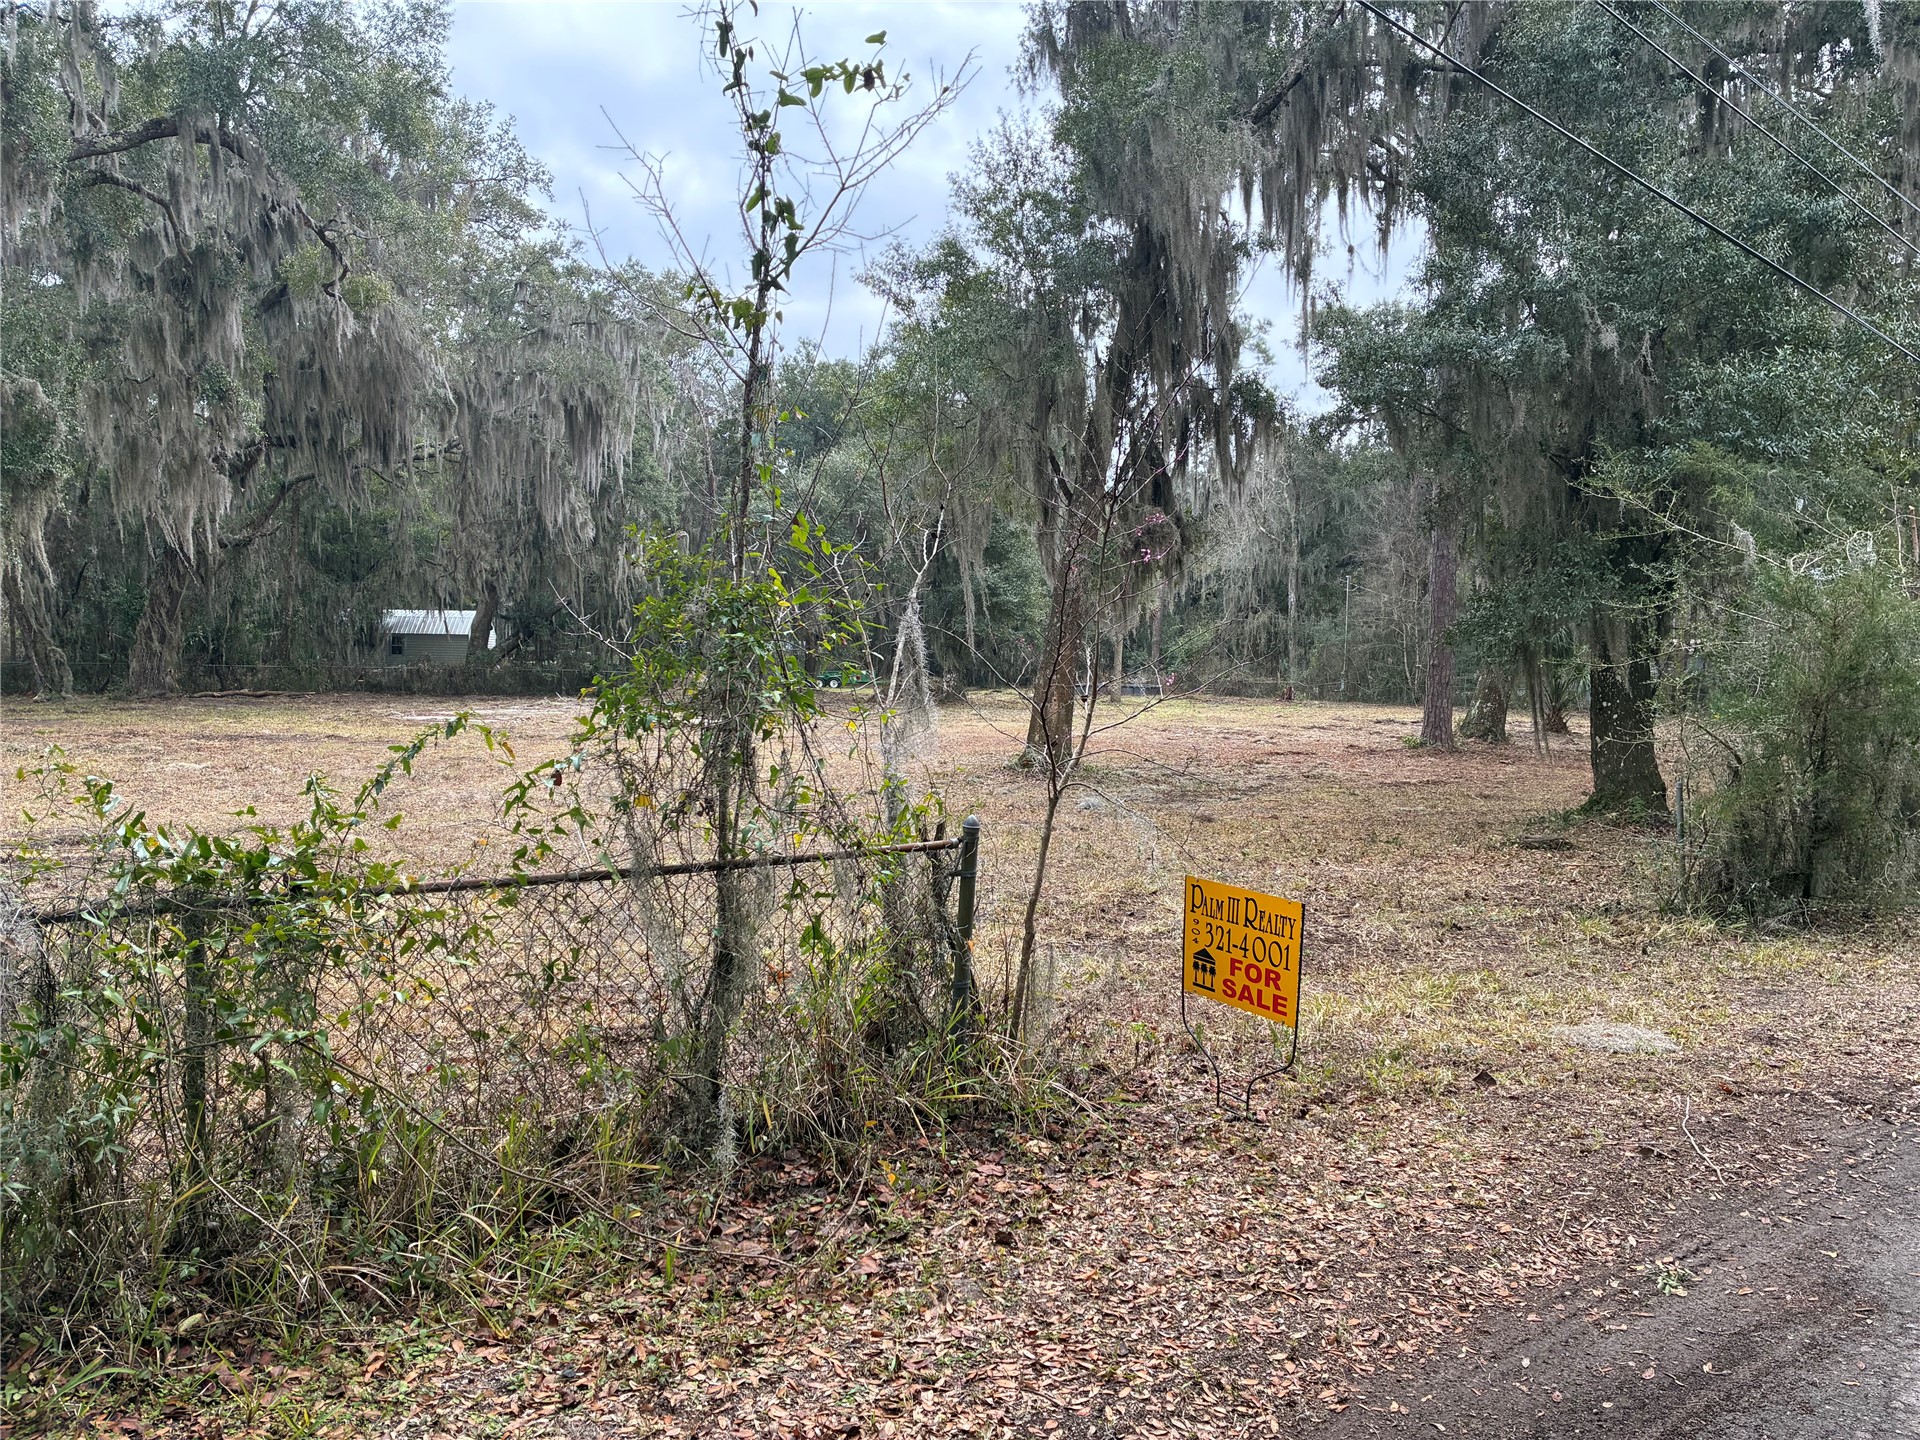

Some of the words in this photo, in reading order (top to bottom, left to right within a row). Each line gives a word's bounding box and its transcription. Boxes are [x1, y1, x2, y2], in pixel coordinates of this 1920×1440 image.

[1190, 884, 1224, 921] PALM
[1227, 896, 1240, 925] III
[1243, 897, 1296, 940] REALTY
[1191, 918, 1201, 944] 904
[1204, 921, 1291, 971] 321-4001
[1229, 957, 1282, 991] FOR
[1222, 978, 1288, 1017] SALE
